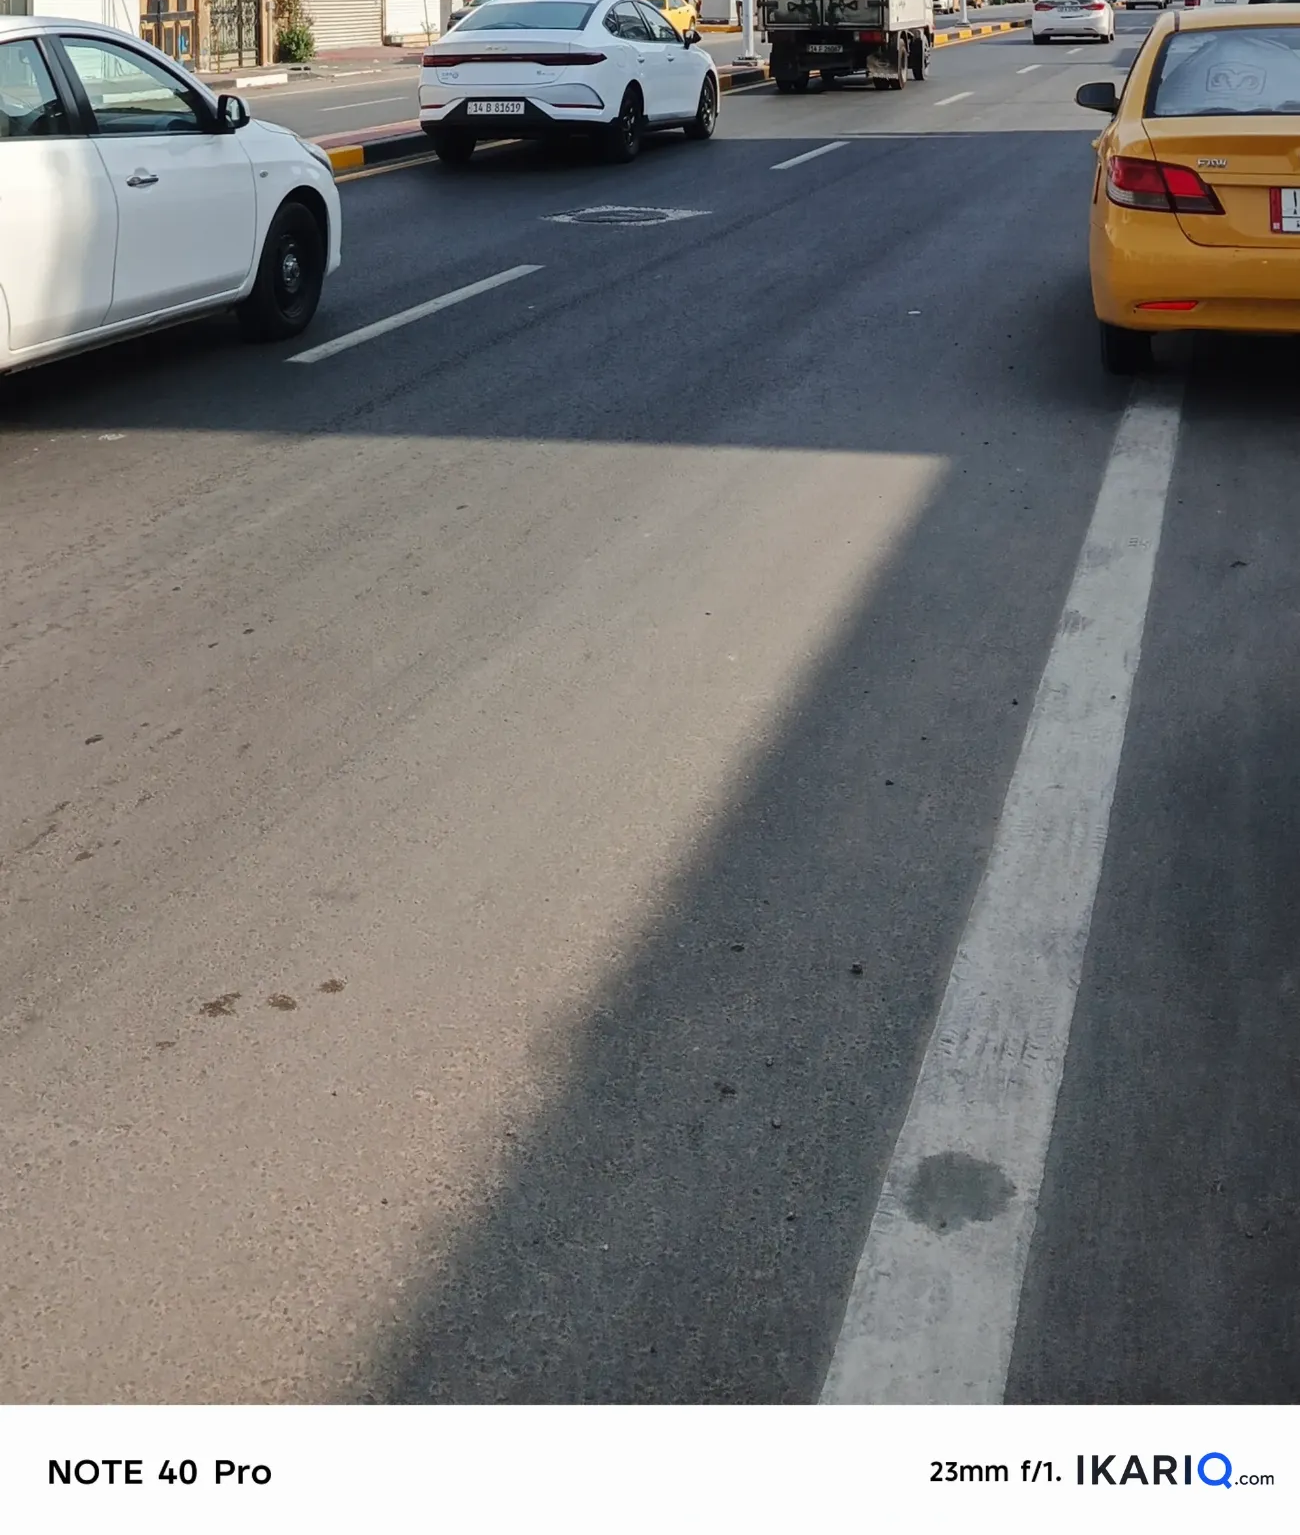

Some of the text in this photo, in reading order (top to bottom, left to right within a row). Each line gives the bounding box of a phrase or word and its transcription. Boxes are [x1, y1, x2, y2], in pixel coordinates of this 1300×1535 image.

[472, 103, 521, 113] 14 B 81619
